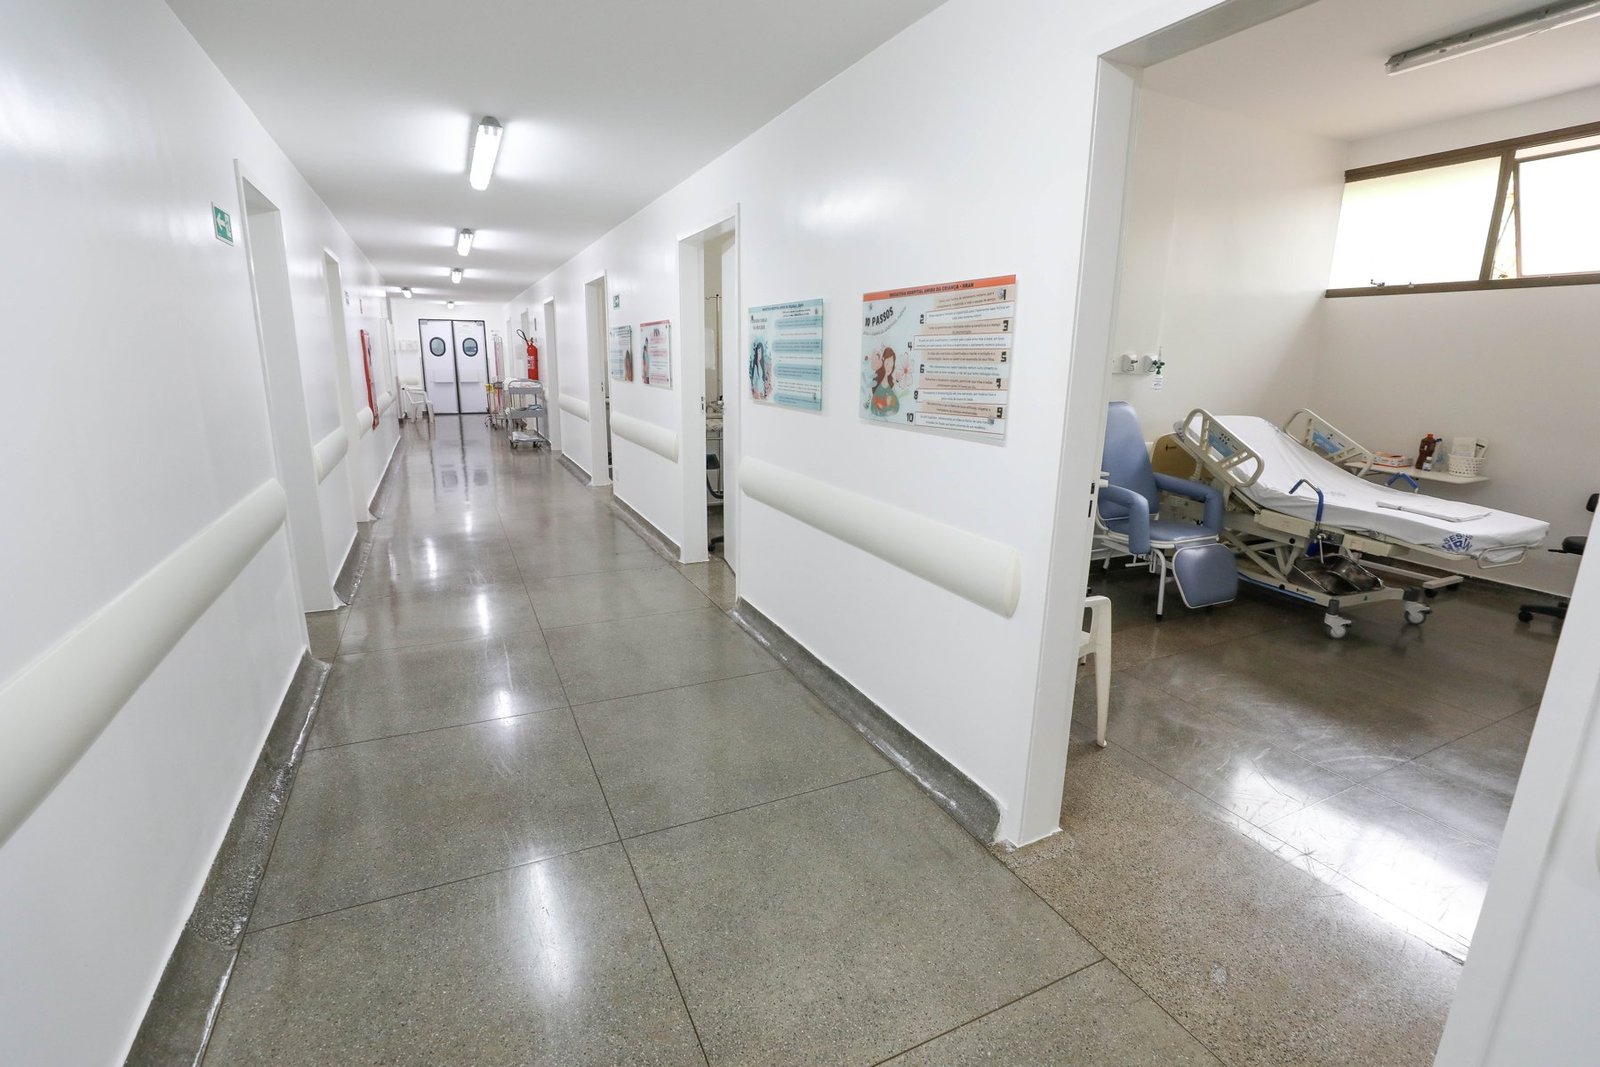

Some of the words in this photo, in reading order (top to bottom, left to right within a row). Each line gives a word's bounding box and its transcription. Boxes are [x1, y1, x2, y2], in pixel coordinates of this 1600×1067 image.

[865, 317, 871, 327] 10
[871, 306, 894, 327] PASSOS
[919, 314, 925, 324] 2
[1003, 320, 1009, 331] 3
[907, 341, 913, 351] 4
[1000, 351, 1007, 362] 5
[919, 364, 925, 374] 6
[995, 378, 1002, 389] 7
[914, 390, 919, 400] 8
[906, 412, 914, 423] 10
[996, 406, 1003, 418] 9
